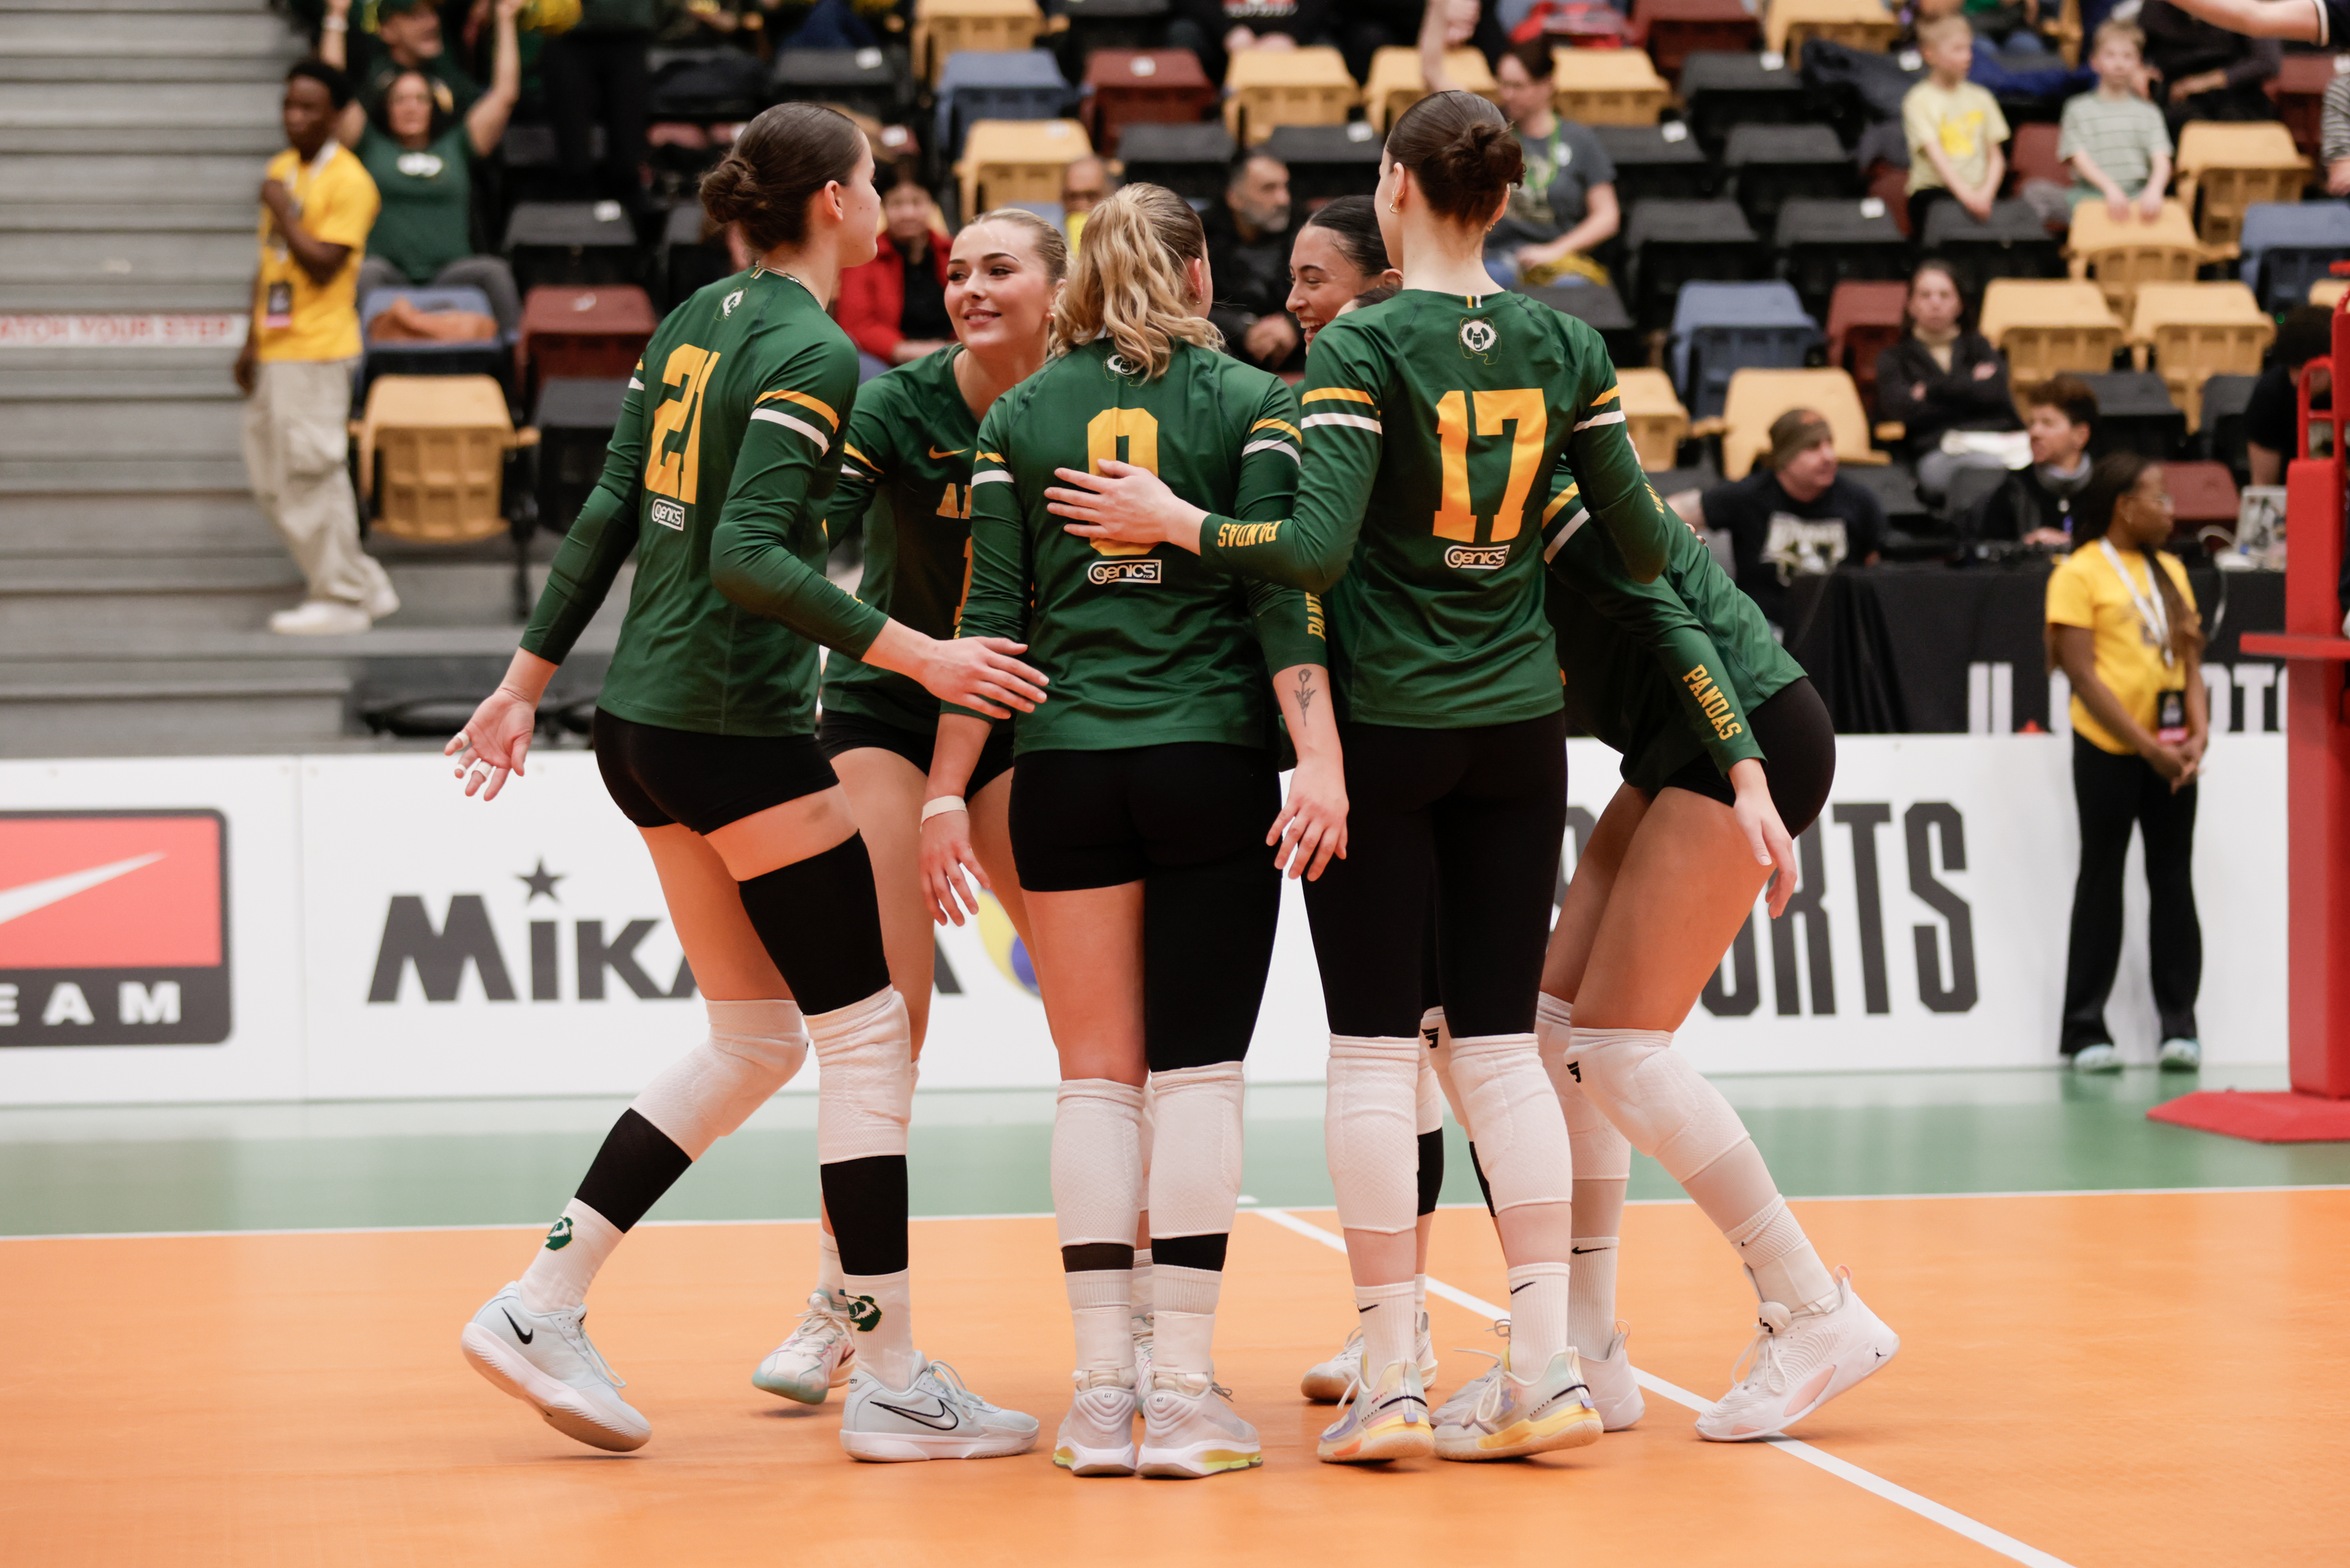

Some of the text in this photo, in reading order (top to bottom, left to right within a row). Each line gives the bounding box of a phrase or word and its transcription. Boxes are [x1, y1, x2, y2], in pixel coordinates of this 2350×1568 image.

[79, 315, 150, 343] YOUR
[163, 315, 234, 343] STEP
[645, 343, 721, 504] 21
[1433, 388, 1548, 543] 17
[1217, 520, 1282, 548] PANDAS
[1447, 548, 1507, 568] genics
[1090, 561, 1158, 584] genics
[1682, 664, 1743, 740] PANDAS
